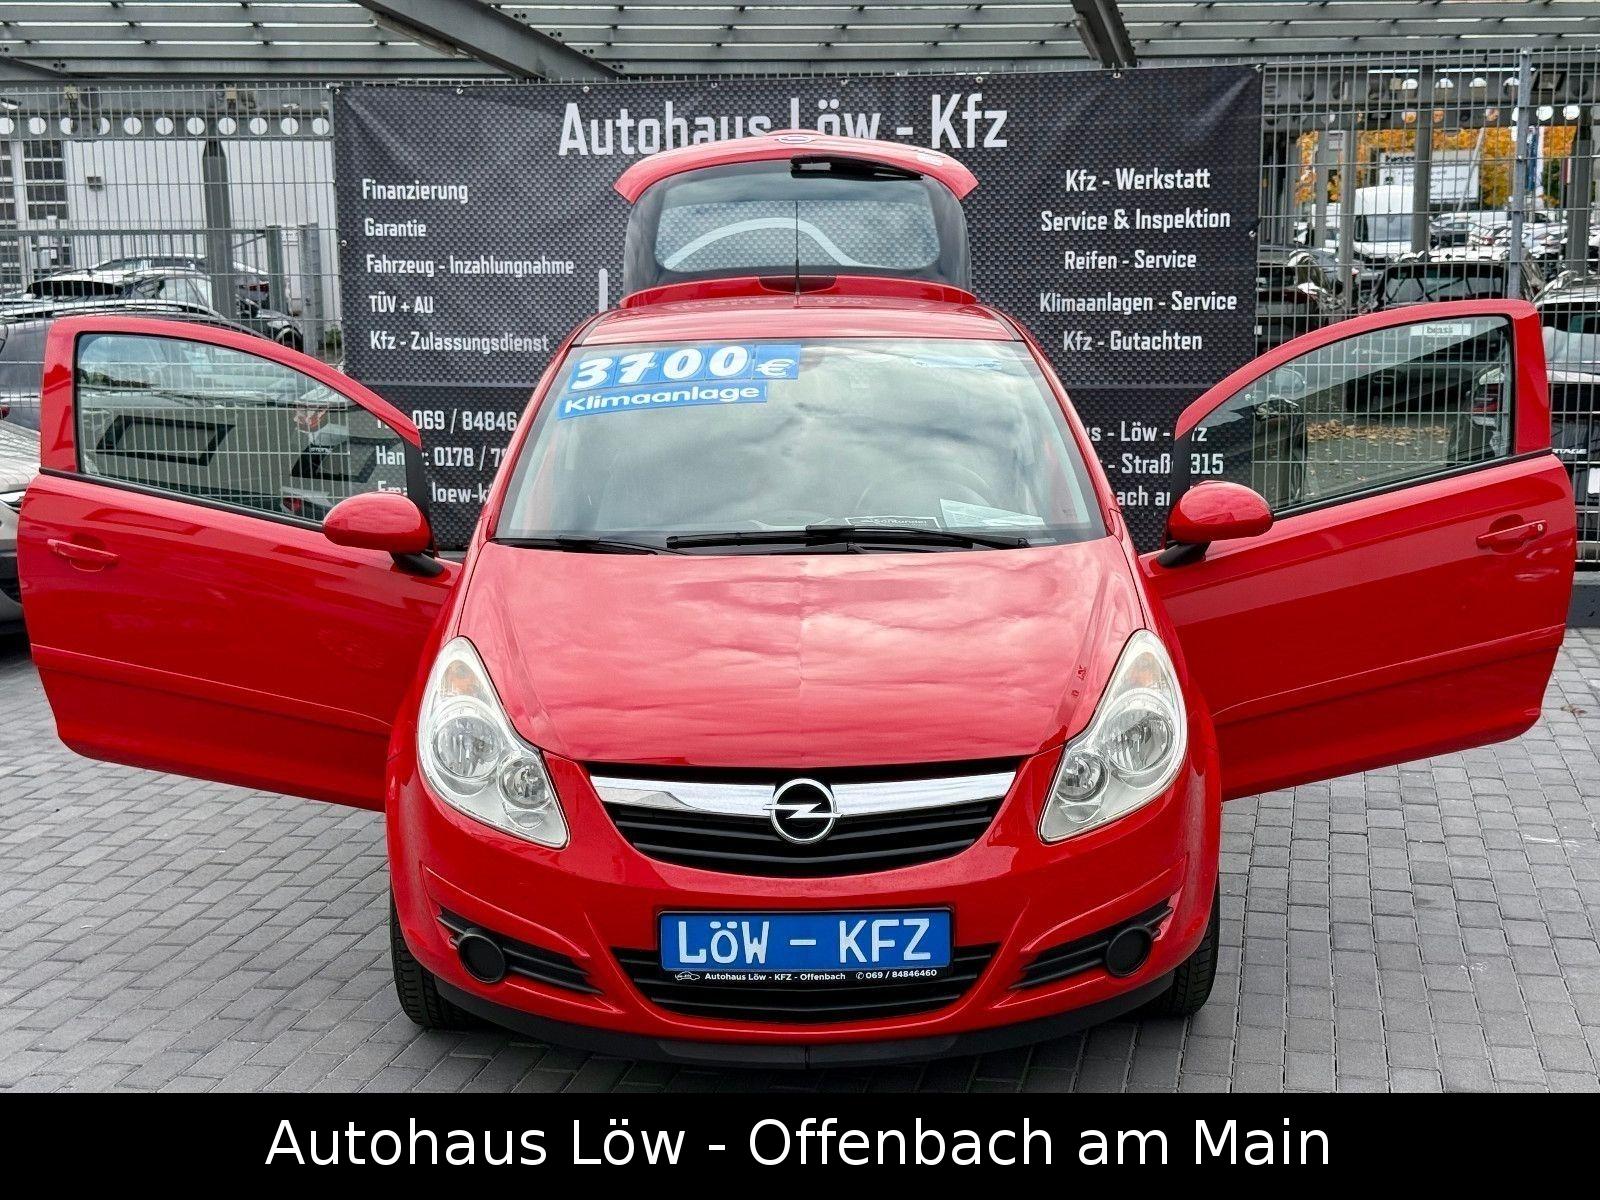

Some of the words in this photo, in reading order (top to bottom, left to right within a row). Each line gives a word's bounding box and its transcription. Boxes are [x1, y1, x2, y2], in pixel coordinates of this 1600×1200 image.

[896, 126, 914, 136] -
[931, 93, 1008, 149] Kfz
[362, 178, 469, 204] Finanzierung
[1065, 169, 1097, 192] Kfz
[1115, 167, 1211, 190] Werkstatt
[364, 217, 427, 237] Garantie
[1041, 210, 1108, 232] Service
[1114, 208, 1130, 230] &
[1135, 207, 1231, 233] Inspektion
[366, 254, 435, 278] Fahrzeug
[449, 255, 574, 278] Inzahlungnahme
[1064, 250, 1117, 270] Reifen
[1134, 250, 1197, 269] Service
[369, 291, 397, 313] TÜV
[400, 302, 411, 313] +
[414, 296, 434, 313] AU
[1039, 292, 1154, 315] Klimaanlagen
[1171, 290, 1238, 311] Service
[370, 330, 396, 350] Kfz
[410, 331, 550, 355] Zulassungsdienst
[1063, 330, 1093, 351] Kfz
[1110, 330, 1203, 350] Gutachten
[571, 345, 748, 391] 3700
[755, 358, 796, 377] €
[564, 386, 760, 414] Klimaanlage
[412, 409, 445, 430] 069
[450, 408, 458, 434] /
[1120, 420, 1158, 442] Löw
[434, 446, 474, 467] 0178
[1121, 453, 1174, 474] Straß
[1190, 453, 1224, 475] 315
[839, 918, 931, 963] KFZ
[705, 972, 747, 981] Autohaus
[748, 972, 766, 981] Löw
[774, 973, 792, 981] KFZ
[800, 972, 846, 981] Offenbach
[891, 969, 938, 979] 84846460
